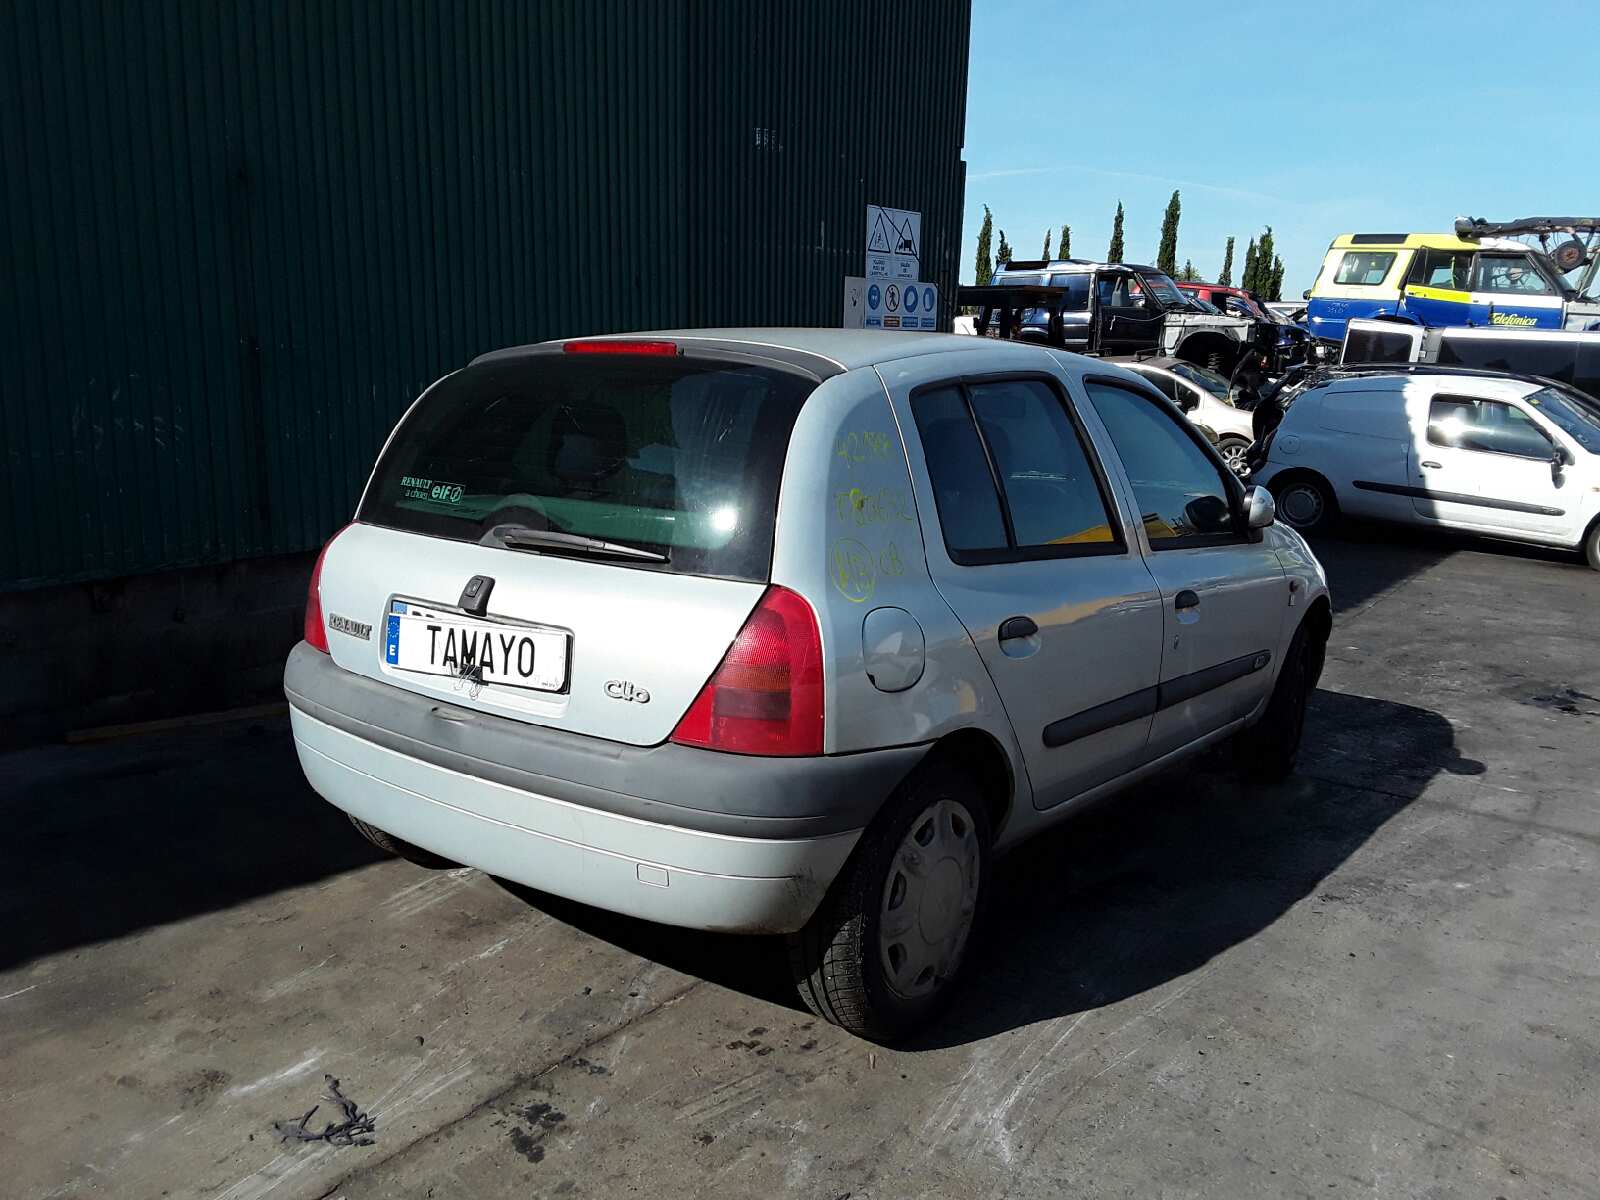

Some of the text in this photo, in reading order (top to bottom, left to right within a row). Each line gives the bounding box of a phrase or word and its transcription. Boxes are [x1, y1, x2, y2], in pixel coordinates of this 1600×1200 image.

[400, 476, 432, 489] RENAULT
[329, 613, 372, 640] RENAULT
[389, 644, 396, 656] E
[426, 624, 535, 678] TAMAYO
[604, 679, 651, 704] Clio
